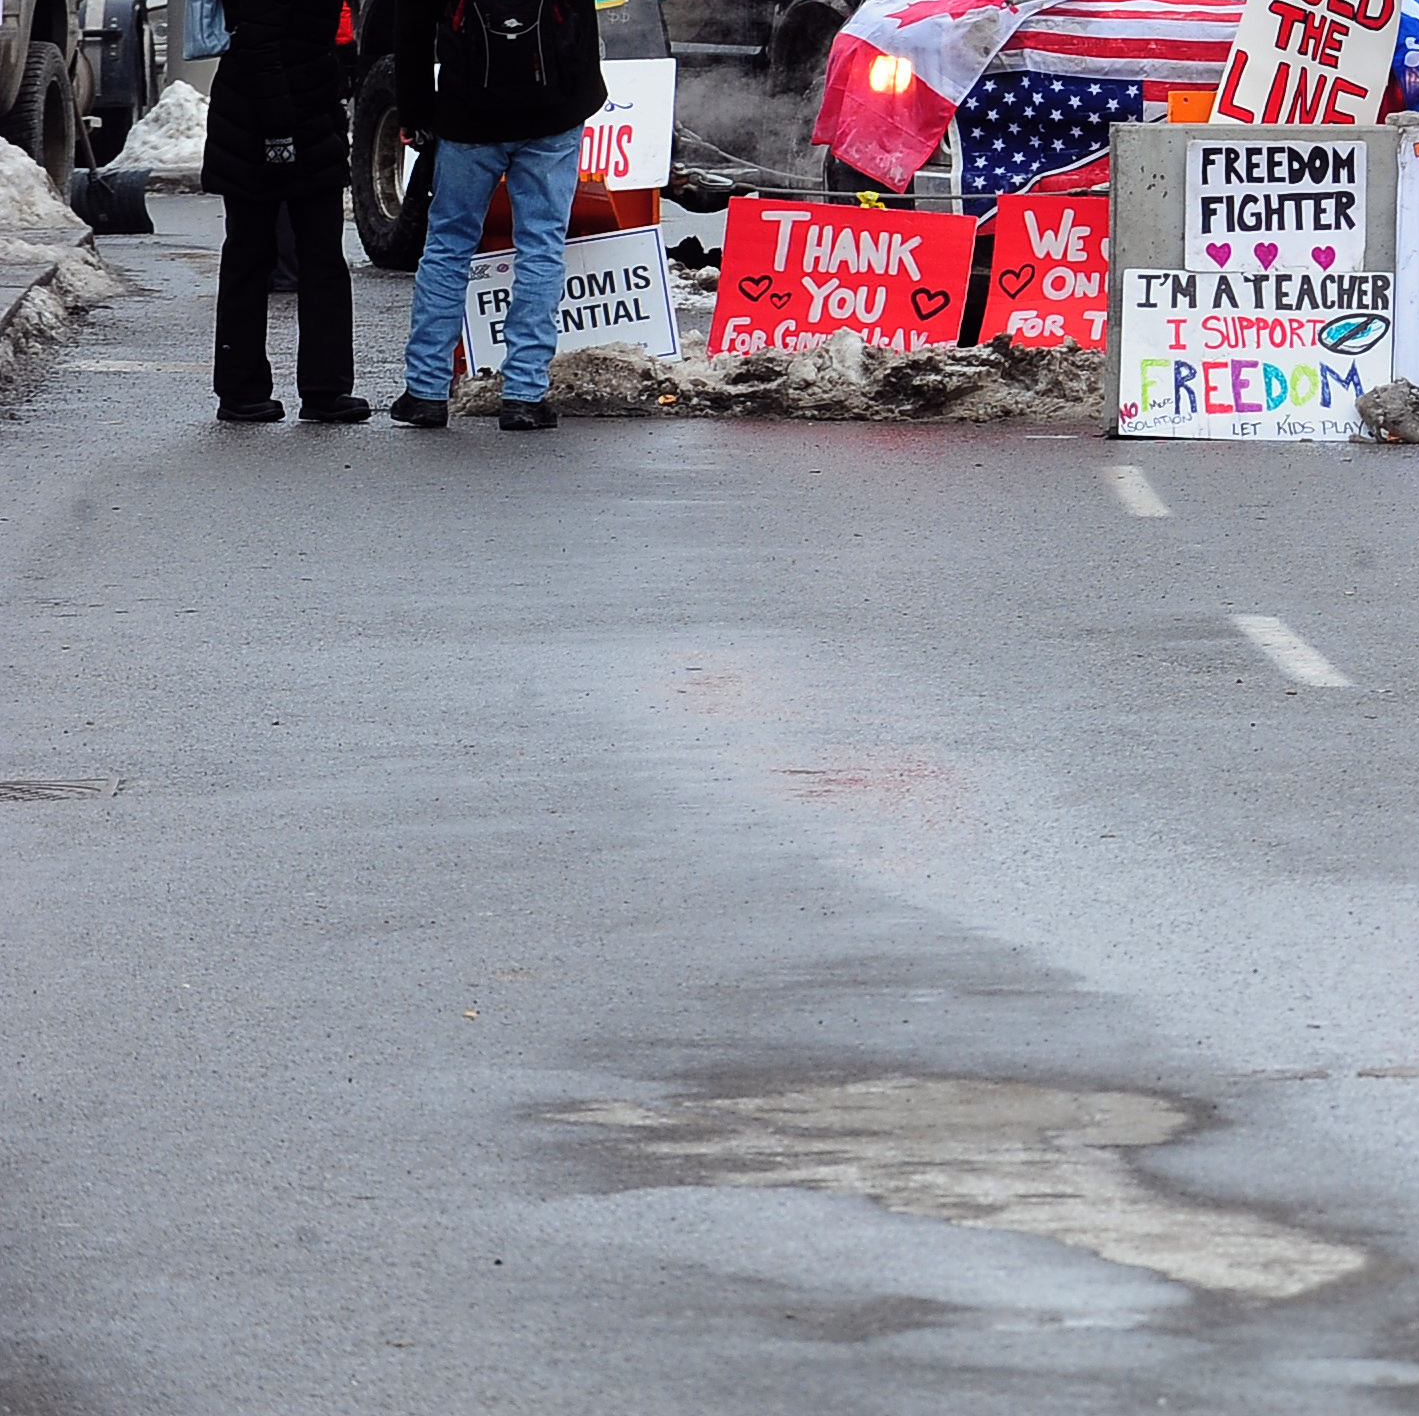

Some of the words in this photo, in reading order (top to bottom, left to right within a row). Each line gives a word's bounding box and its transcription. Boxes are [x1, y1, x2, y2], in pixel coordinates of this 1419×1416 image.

[1218, 48, 1369, 124] LINE
[1200, 145, 1356, 185] FREEDOM
[1200, 192, 1356, 235] FIGHTER
[761, 210, 923, 282] THANK
[1023, 208, 1091, 263] WE
[622, 265, 652, 292] IS
[1137, 274, 1199, 310] I'M
[1213, 273, 1240, 310] A
[1245, 273, 1391, 311] TEACHER
[801, 275, 886, 324] YOU
[721, 316, 767, 353] FOR
[1007, 310, 1065, 338] FOR
[1165, 317, 1188, 352] I
[1202, 316, 1324, 352] SUPPORT
[1140, 359, 1365, 414] FREEDOM
[1231, 421, 1262, 436] LET
[1276, 414, 1316, 435] KIDS
